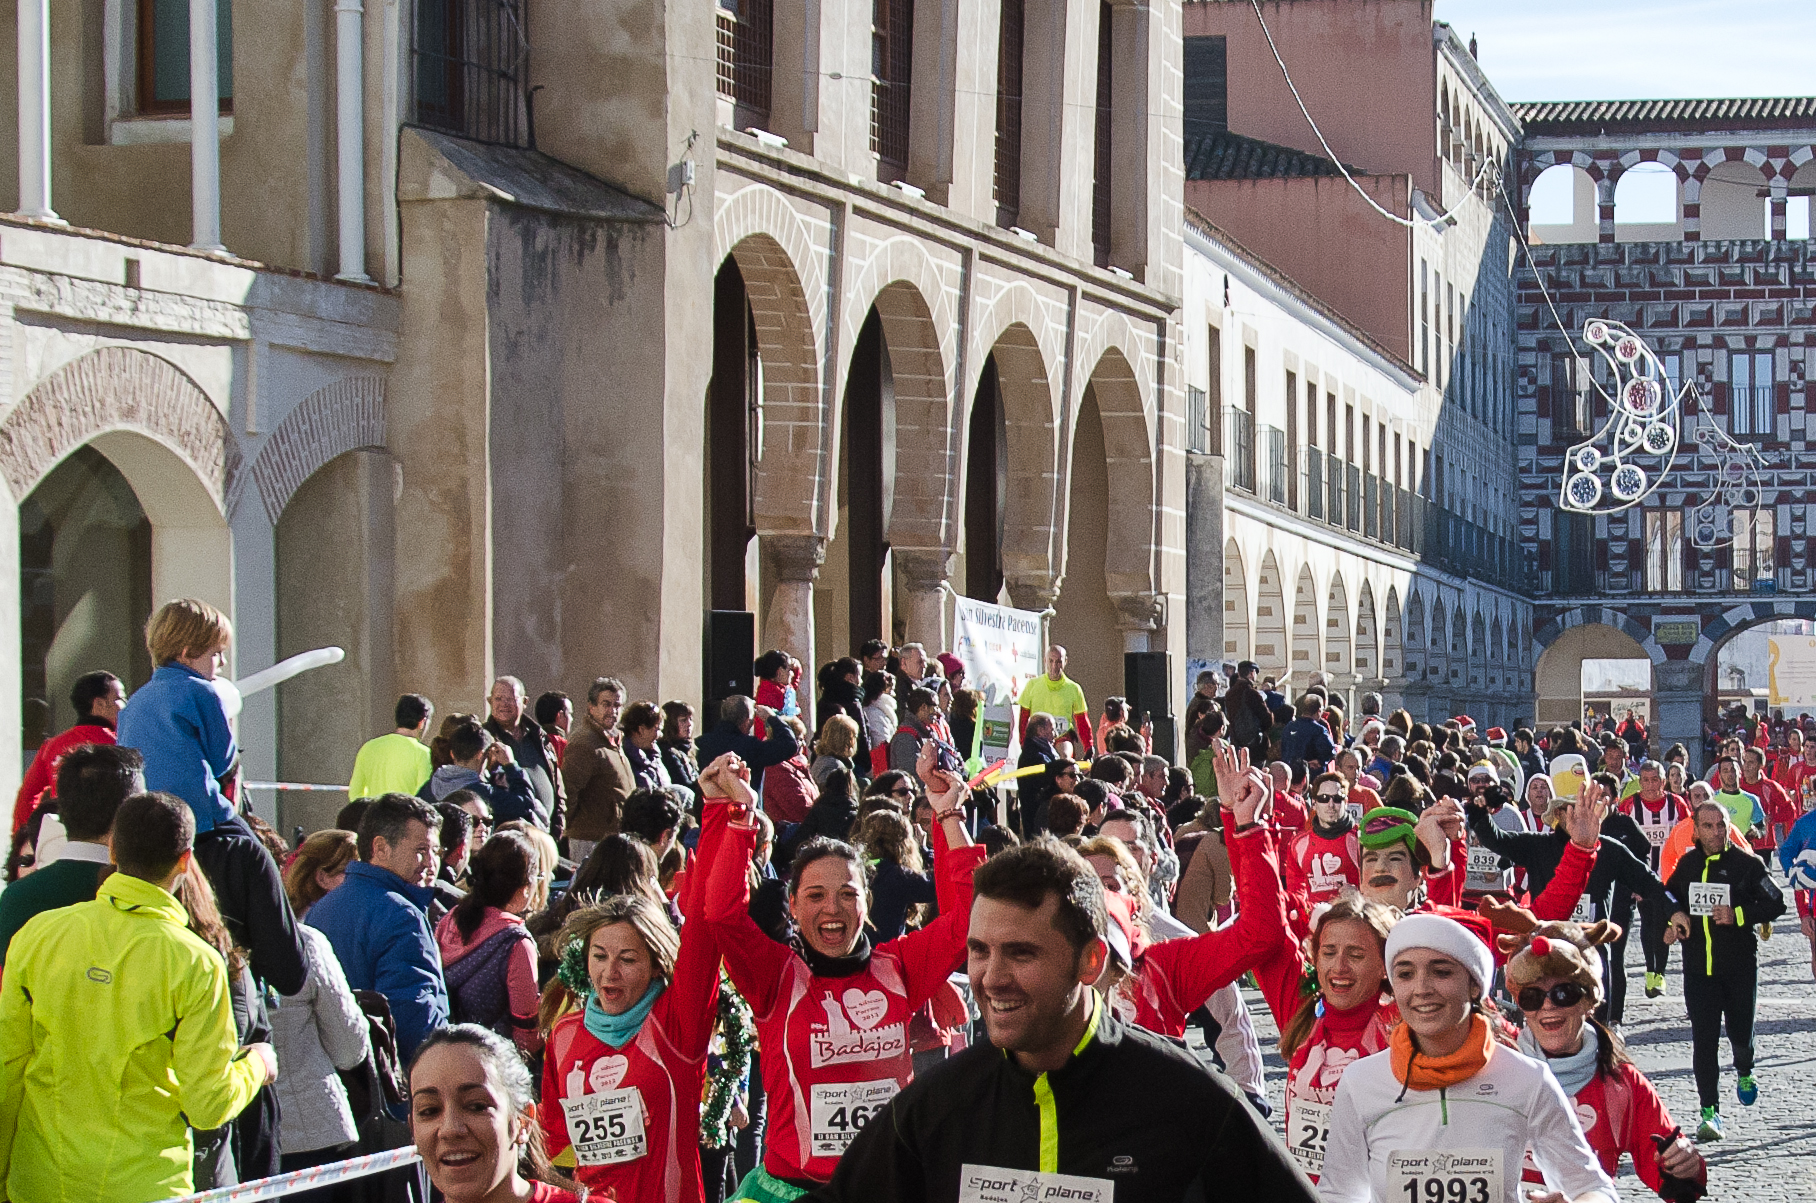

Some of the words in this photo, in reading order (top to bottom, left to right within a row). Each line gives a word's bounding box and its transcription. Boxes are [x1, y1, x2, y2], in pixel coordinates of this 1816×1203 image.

[1007, 614, 1038, 637] Pacense
[1473, 855, 1495, 865] 839
[1695, 893, 1724, 905] 2167
[814, 1036, 903, 1062] Badajoz
[574, 1113, 626, 1143] 255
[828, 1104, 888, 1131] 46
